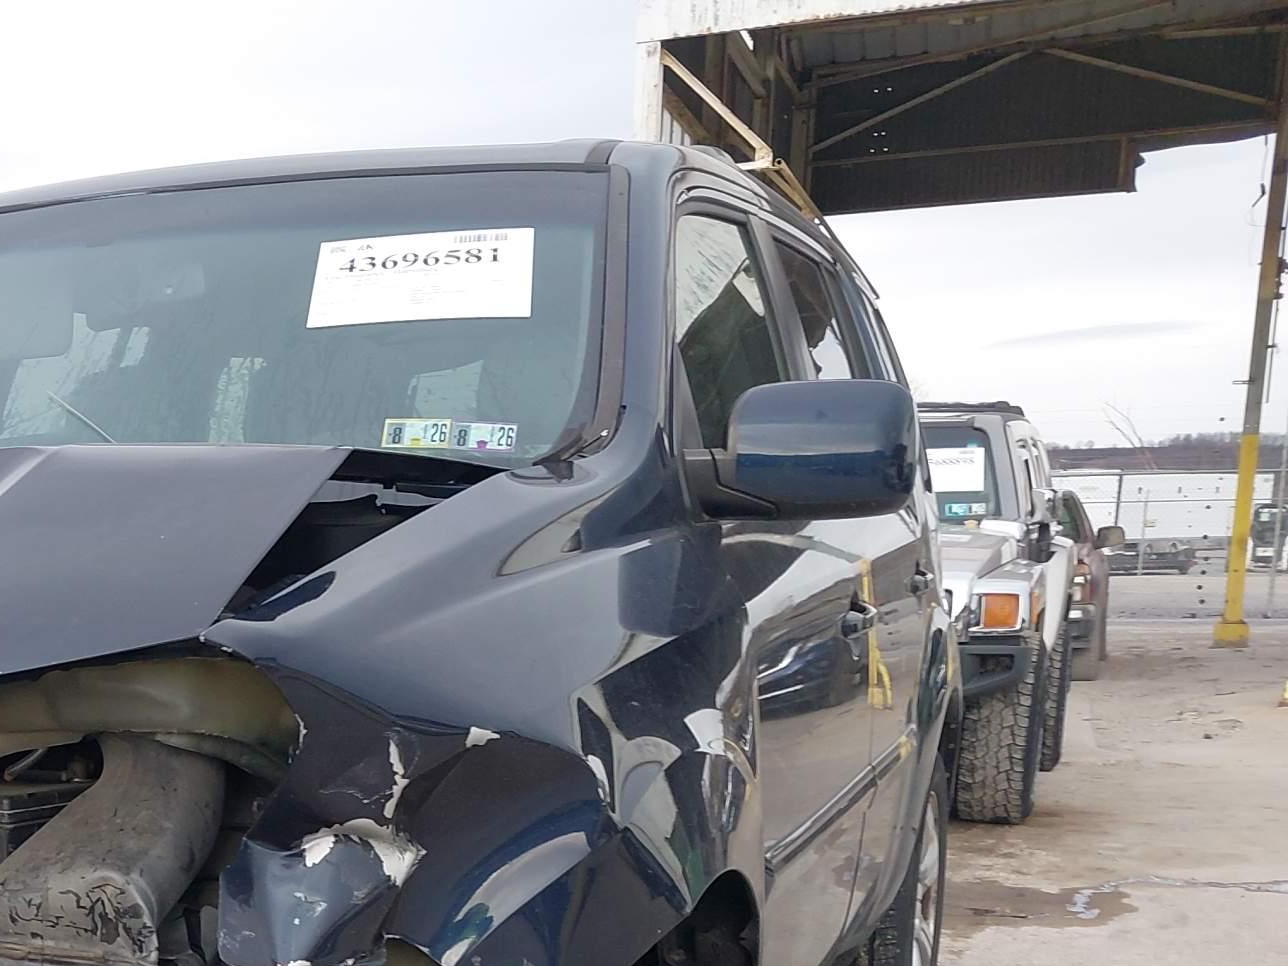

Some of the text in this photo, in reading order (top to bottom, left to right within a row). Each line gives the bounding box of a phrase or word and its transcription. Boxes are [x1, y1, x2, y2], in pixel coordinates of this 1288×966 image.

[339, 247, 500, 273] 43696581
[392, 427, 402, 444] 8
[430, 423, 447, 443] 26
[457, 429, 468, 446] 8
[497, 426, 514, 447] 26
